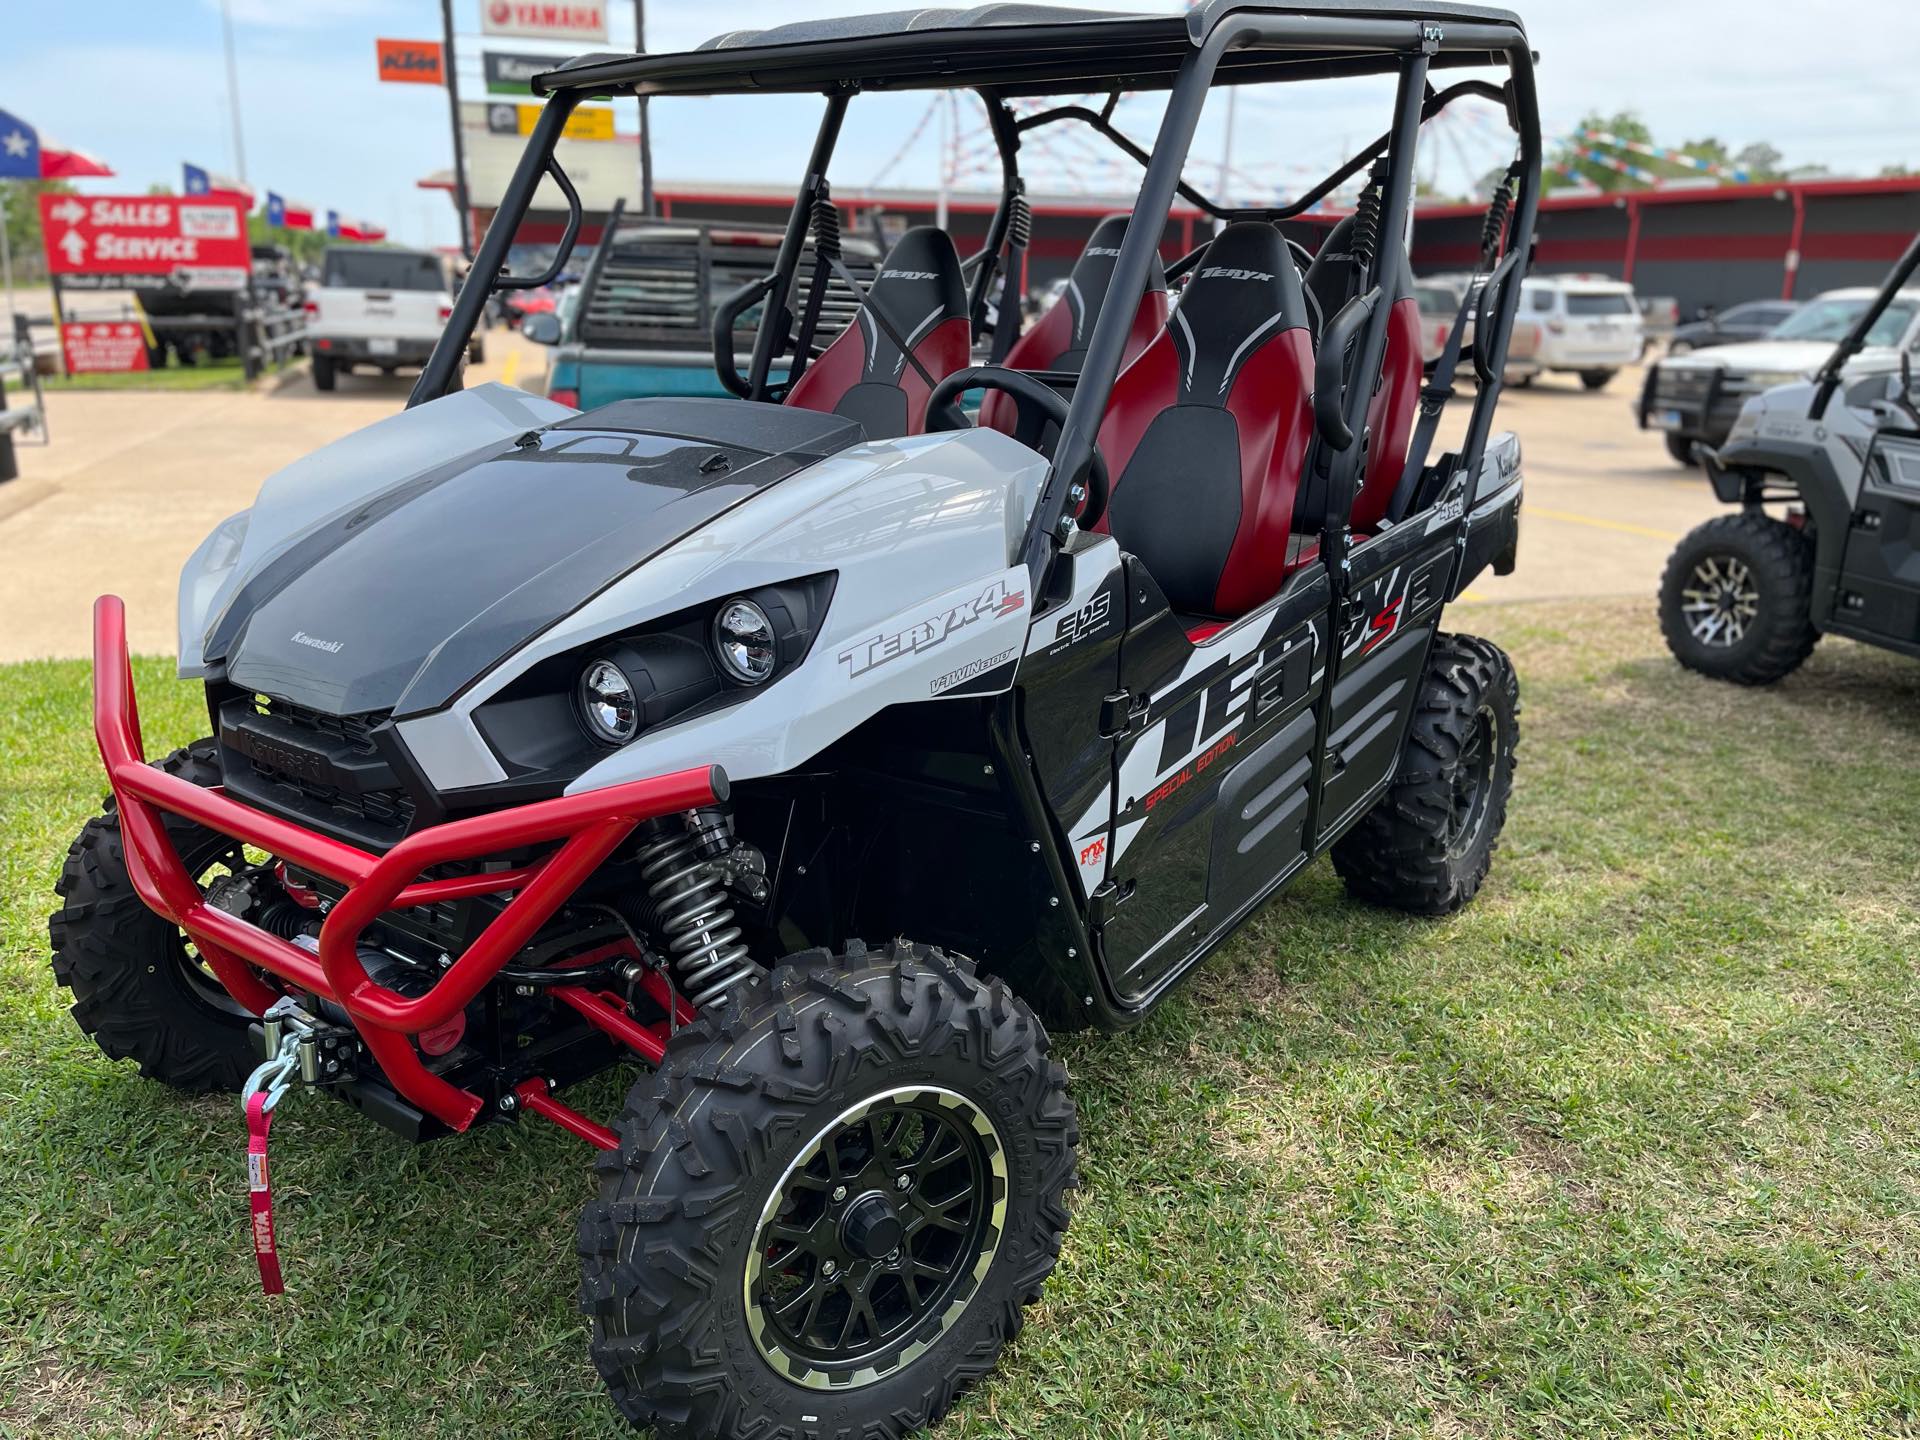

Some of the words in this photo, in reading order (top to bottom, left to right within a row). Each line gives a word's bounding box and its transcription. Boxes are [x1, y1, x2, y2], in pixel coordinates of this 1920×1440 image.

[515, 5, 600, 28] YAMAHA
[91, 200, 170, 226] SALES
[95, 233, 198, 260] SERVICE
[291, 631, 344, 653] Kawasaki
[1145, 767, 1194, 812] SPECIAL
[1196, 730, 1241, 774] EDITION
[1080, 836, 1106, 866] FOX
[254, 1210, 274, 1254] WARN
